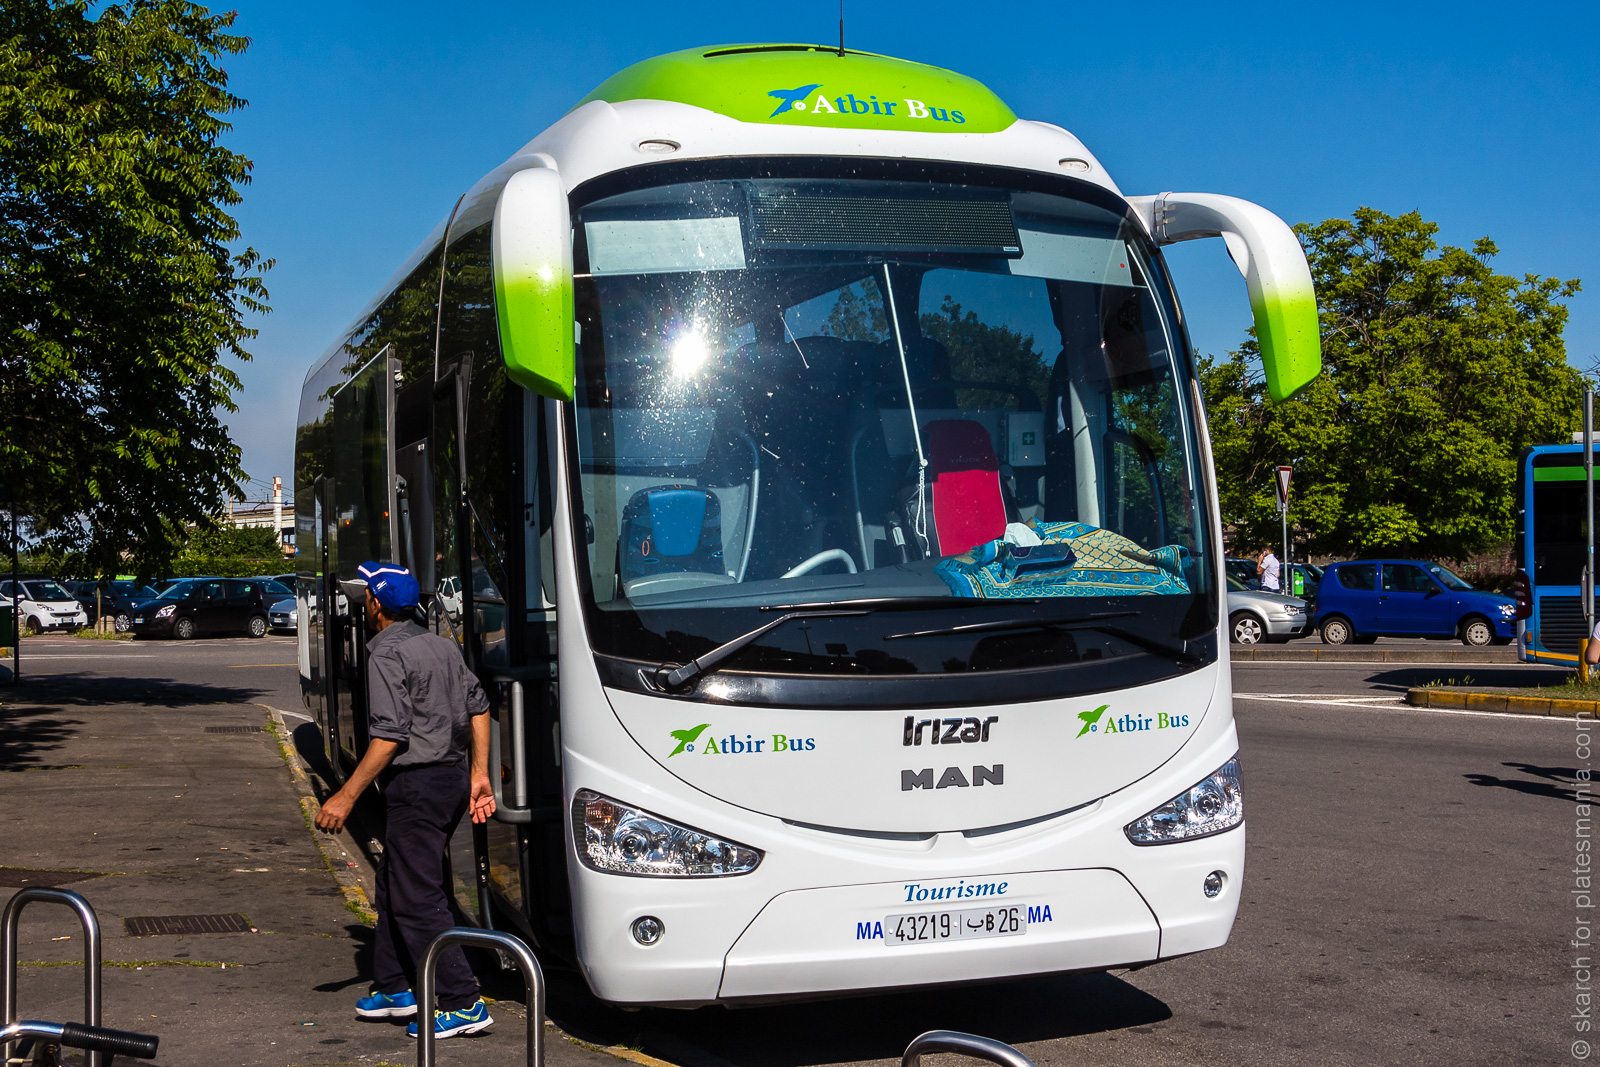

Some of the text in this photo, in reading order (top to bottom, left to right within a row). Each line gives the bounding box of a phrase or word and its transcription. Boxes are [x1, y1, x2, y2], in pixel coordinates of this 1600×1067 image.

[811, 93, 966, 124] Atbir Bus
[1103, 712, 1190, 734] Atbir Bus
[702, 734, 816, 755] Atbir Bus
[901, 764, 1004, 791] MAN
[904, 880, 1009, 902] Tourisme
[895, 913, 951, 942] 43219
[998, 907, 1019, 934] 26
[1027, 904, 1053, 924] MA
[856, 921, 884, 940] MA
